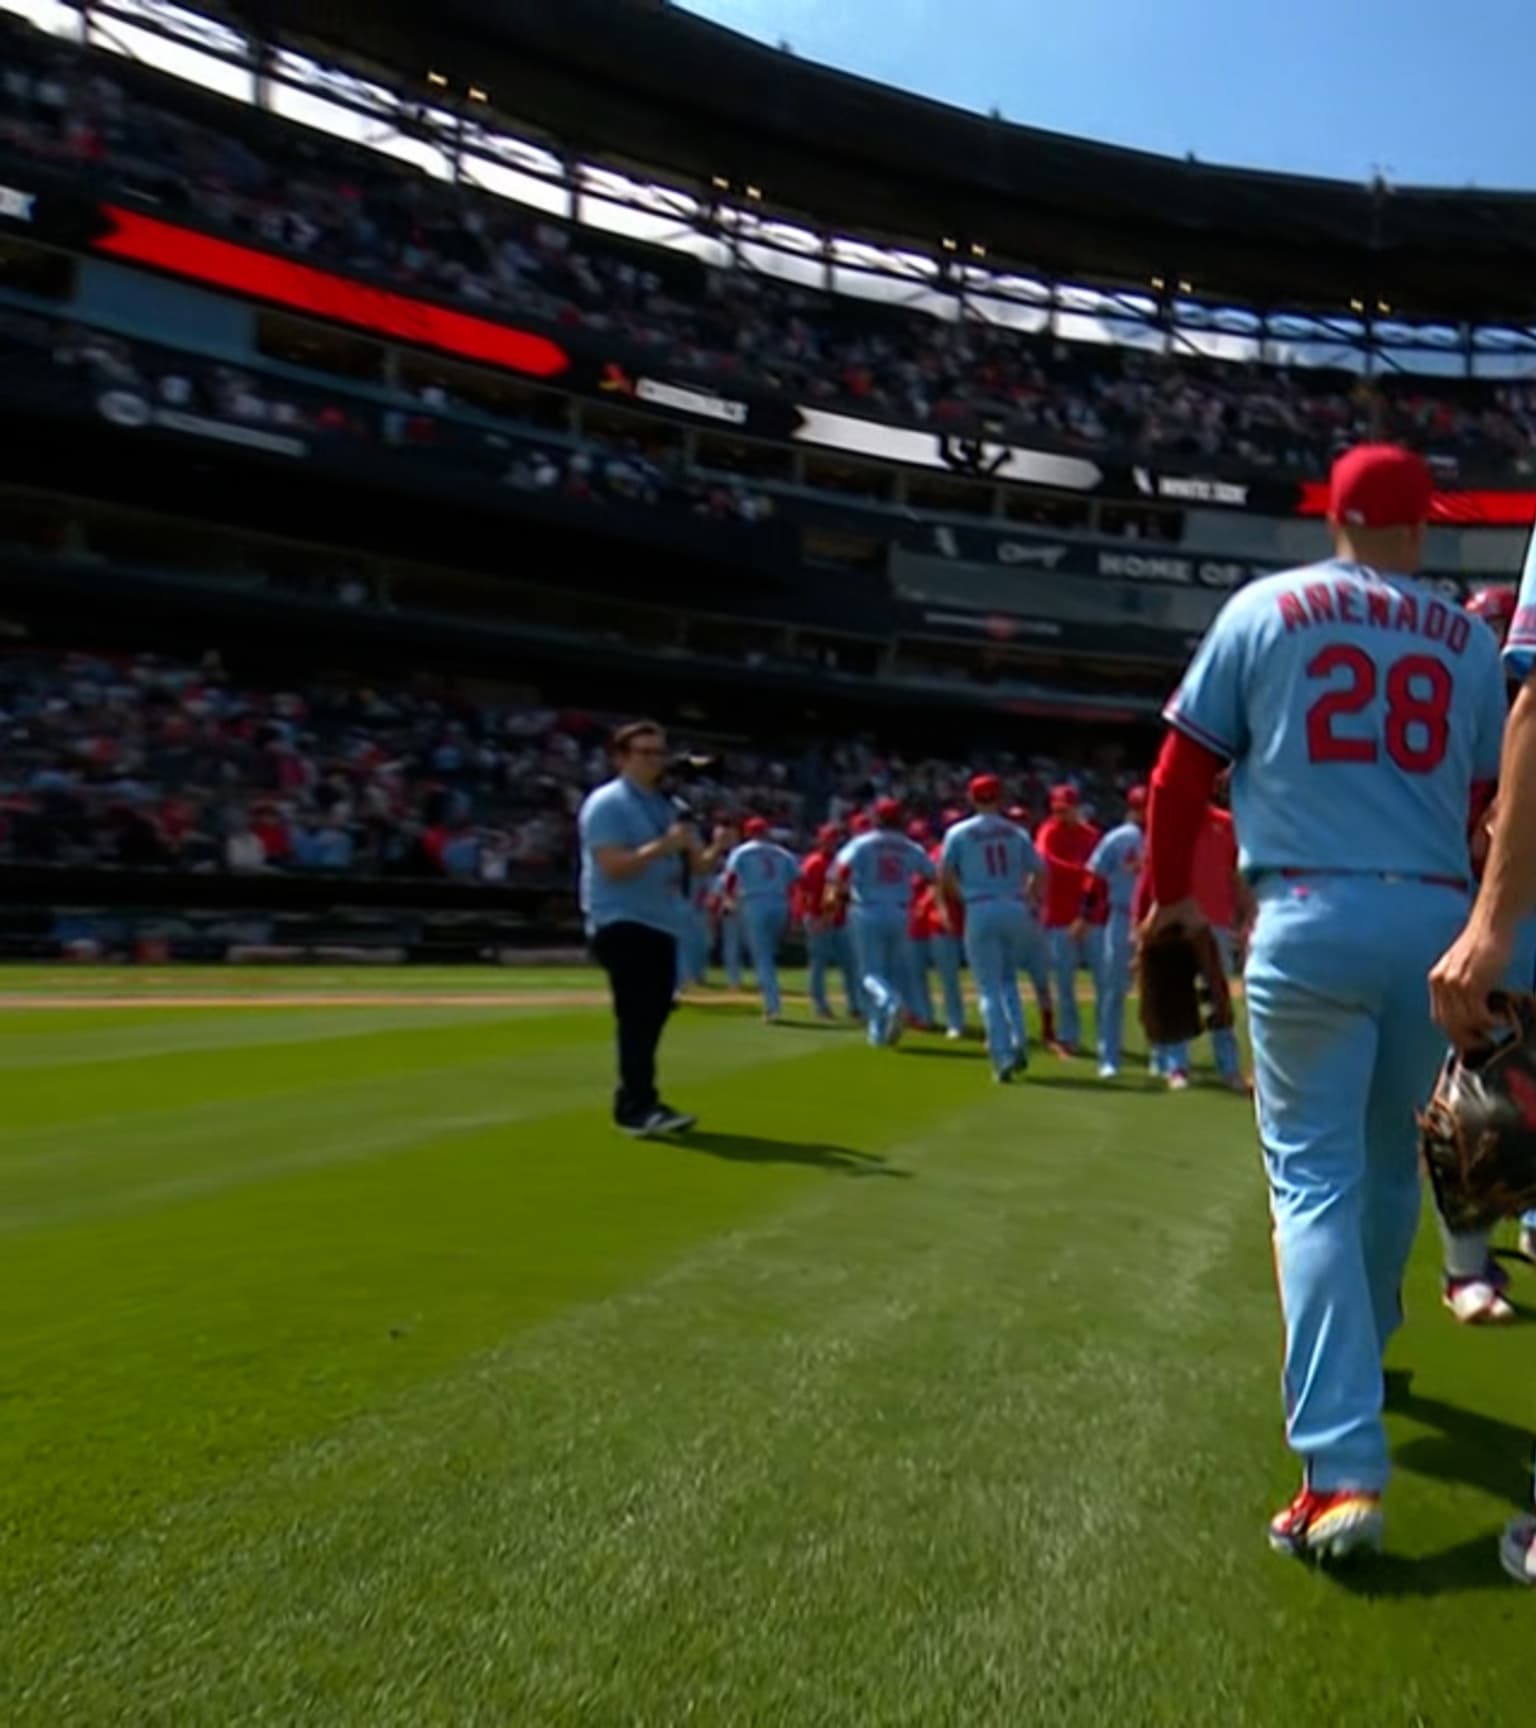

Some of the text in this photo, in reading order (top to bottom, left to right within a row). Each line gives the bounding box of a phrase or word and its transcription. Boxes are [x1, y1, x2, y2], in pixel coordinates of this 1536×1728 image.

[1098, 552, 1191, 582] HOME
[1276, 578, 1472, 657] ARENADO
[1305, 641, 1454, 776] 28
[984, 841, 1009, 879] 11
